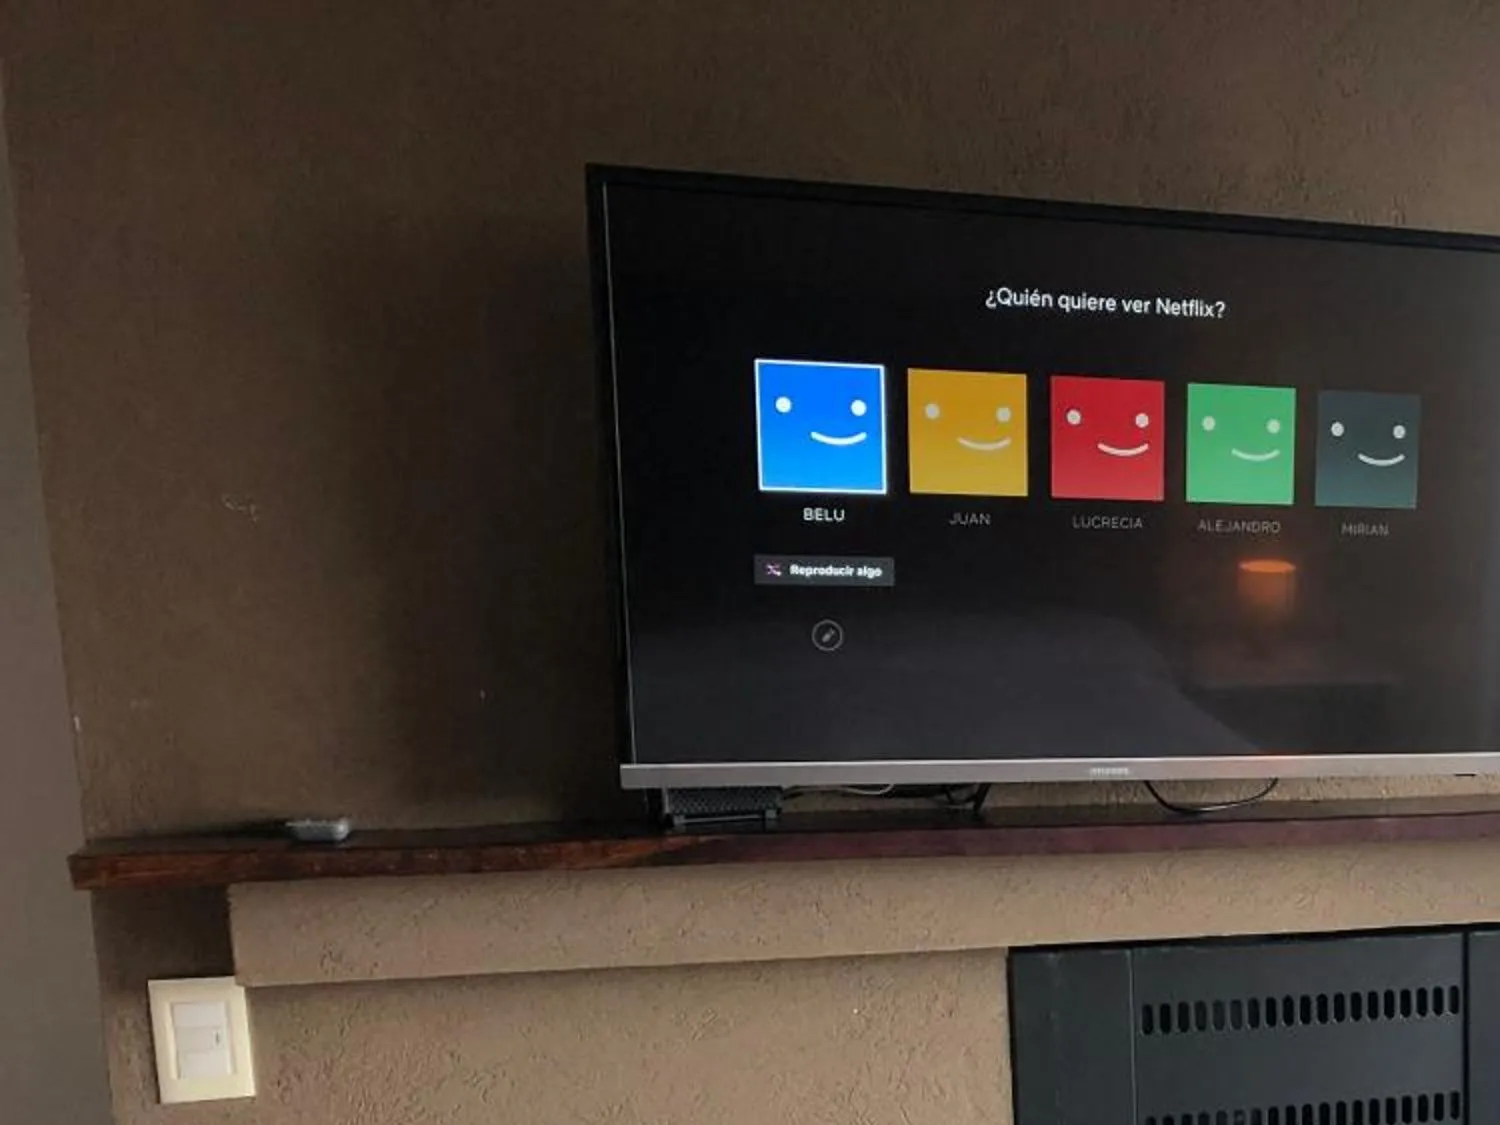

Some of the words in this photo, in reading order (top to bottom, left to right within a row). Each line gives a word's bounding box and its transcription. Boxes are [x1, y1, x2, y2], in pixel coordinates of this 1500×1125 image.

[985, 287, 1053, 309] ¿Quién
[1058, 292, 1117, 313] quiere
[1121, 298, 1150, 313] ver
[1155, 297, 1226, 319] Netflix?
[803, 507, 845, 522] BELU
[948, 511, 991, 526] JUAN
[1072, 515, 1144, 530] LUCRECIA
[1197, 519, 1282, 535] ALEJANDRO
[1341, 522, 1390, 536] MIRIAN
[789, 563, 854, 578] Reproducir
[857, 565, 883, 579] algo
